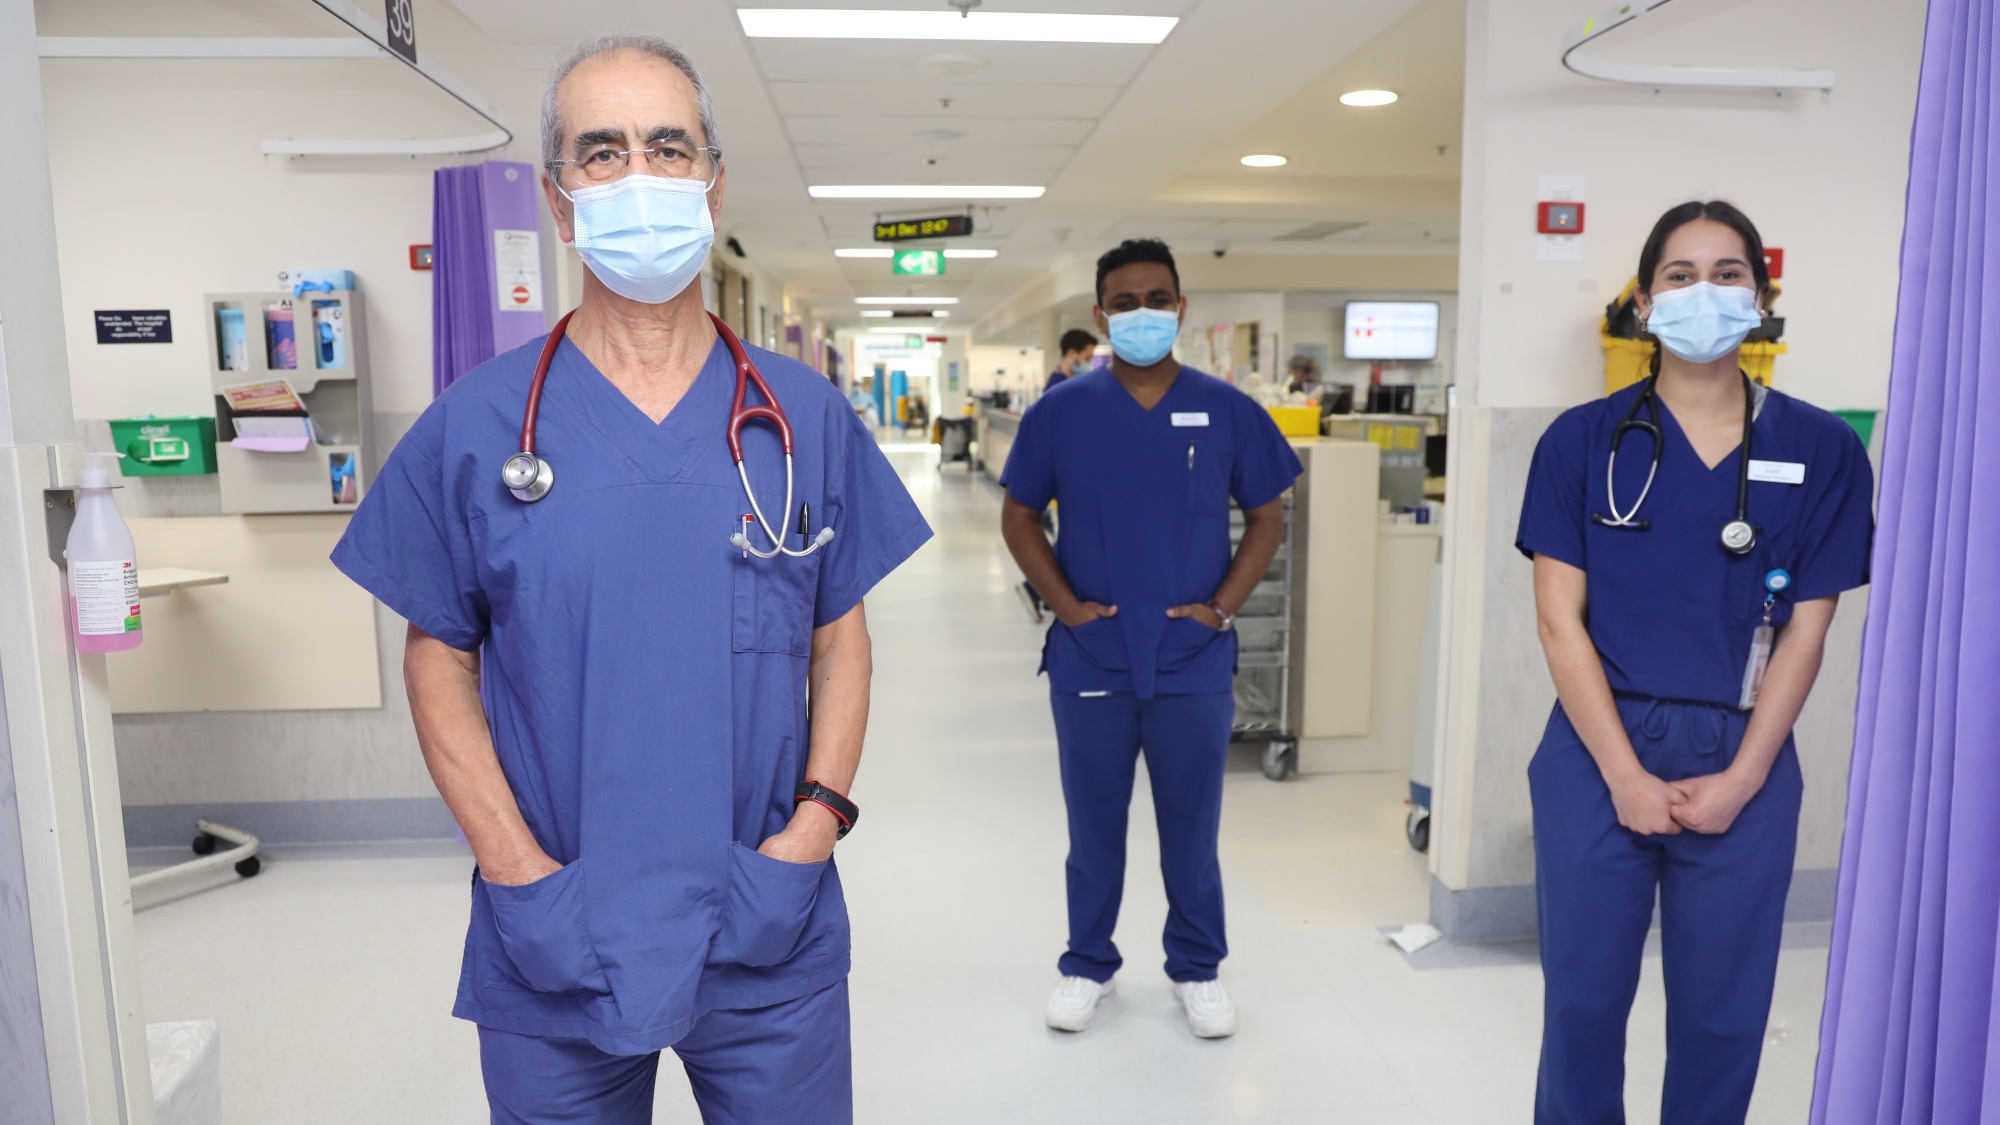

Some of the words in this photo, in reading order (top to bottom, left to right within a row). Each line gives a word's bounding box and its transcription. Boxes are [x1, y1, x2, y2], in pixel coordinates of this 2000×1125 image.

[390, 0, 413, 46] 39
[876, 225, 896, 239] 3rd
[898, 223, 917, 237] Dec
